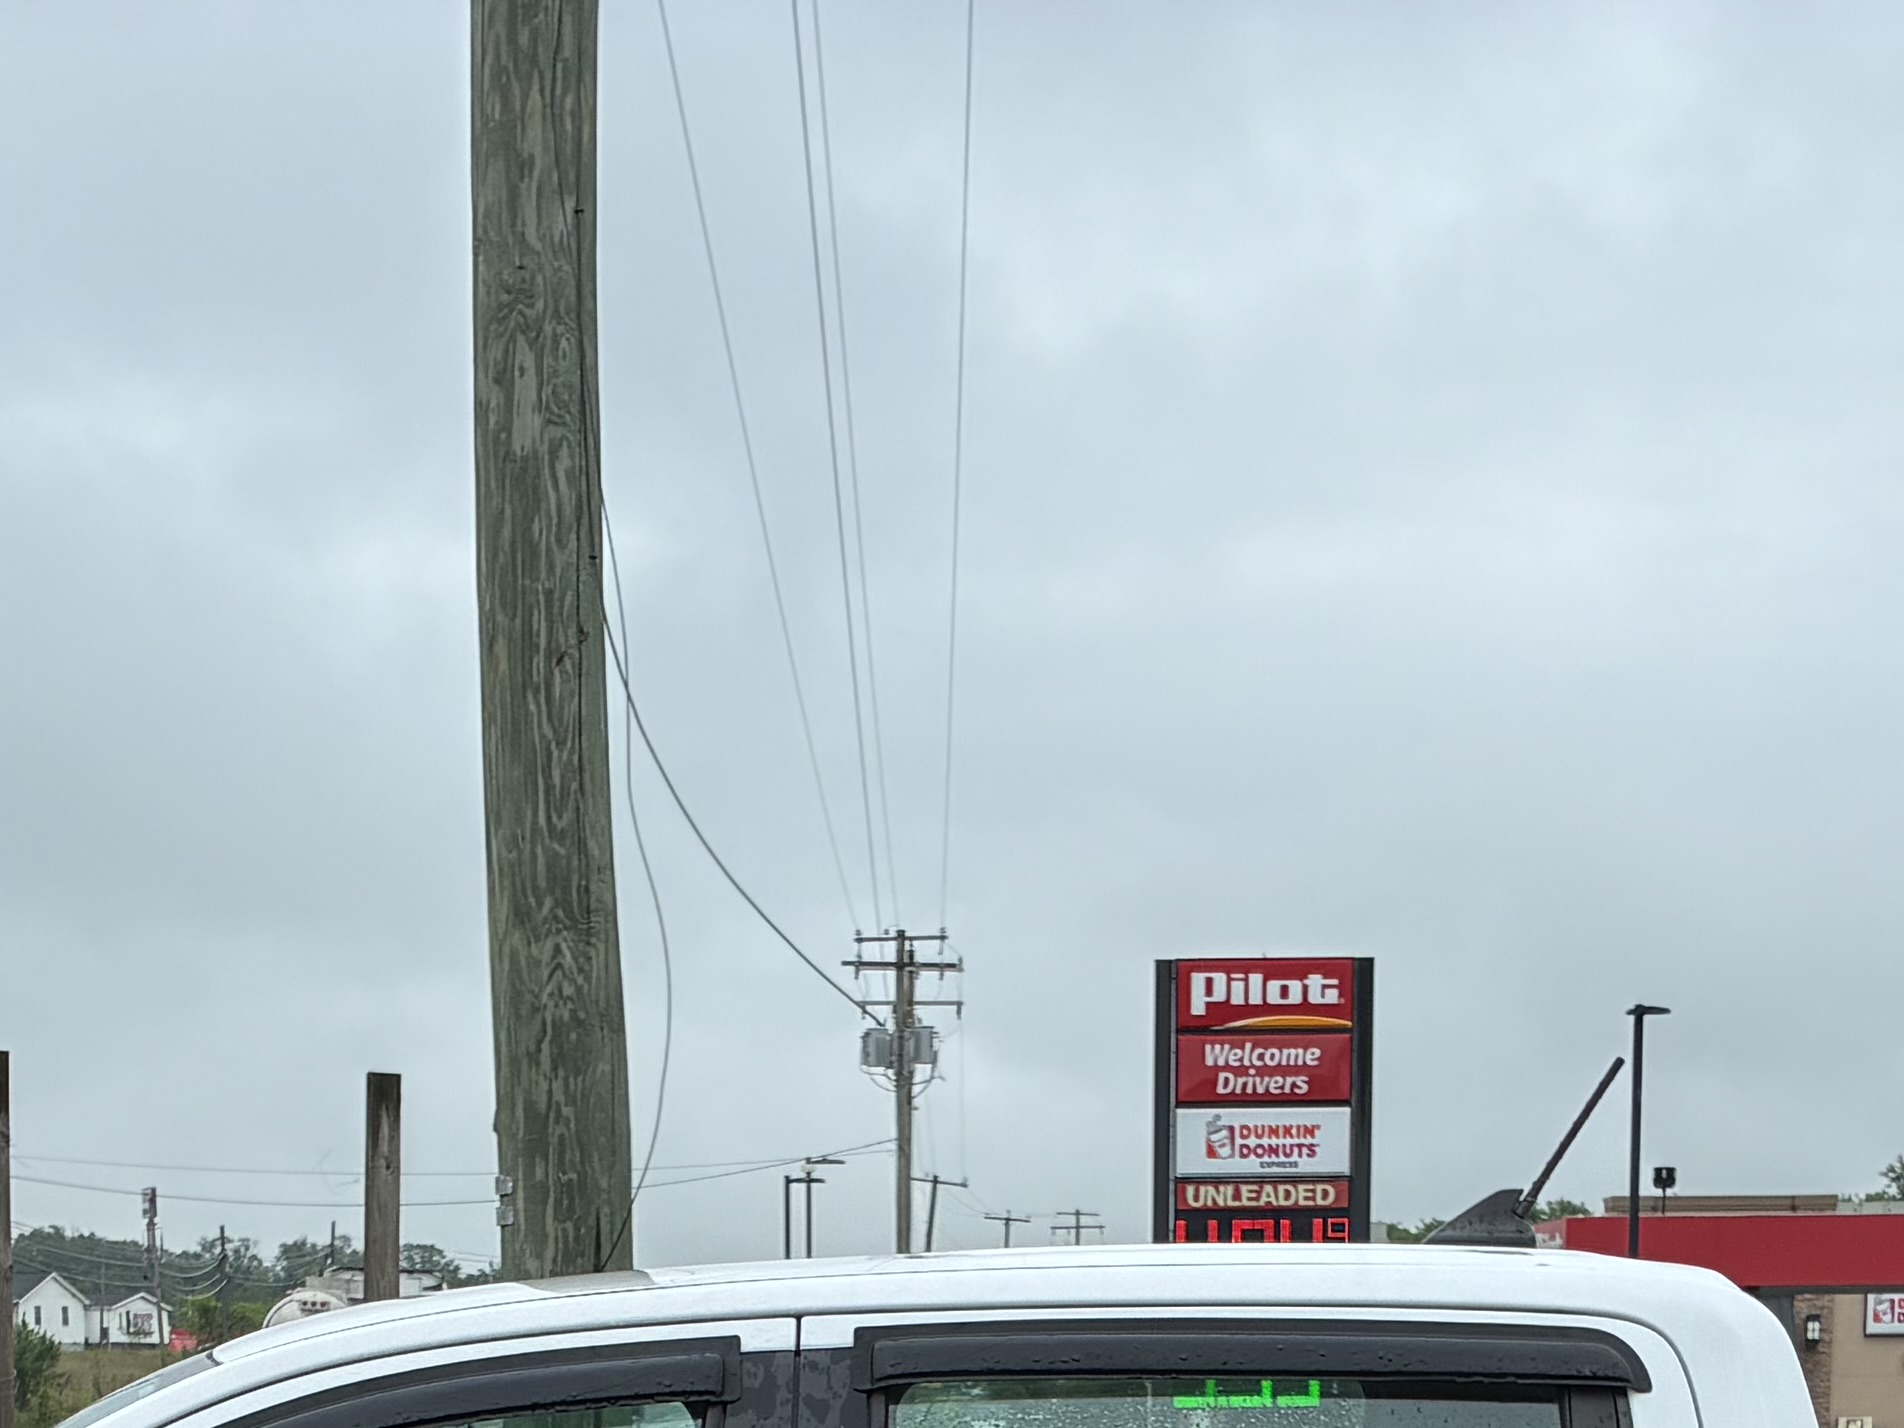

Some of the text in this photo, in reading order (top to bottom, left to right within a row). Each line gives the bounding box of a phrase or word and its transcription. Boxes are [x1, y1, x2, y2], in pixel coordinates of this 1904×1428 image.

[1190, 972, 1340, 1016] Pilot
[1204, 1042, 1321, 1067] Welcome
[1215, 1068, 1309, 1095] Drivers
[1239, 1124, 1319, 1140] DUNKIN'
[1238, 1143, 1318, 1159] DONUTS
[1185, 1183, 1336, 1207] UNLEADED
